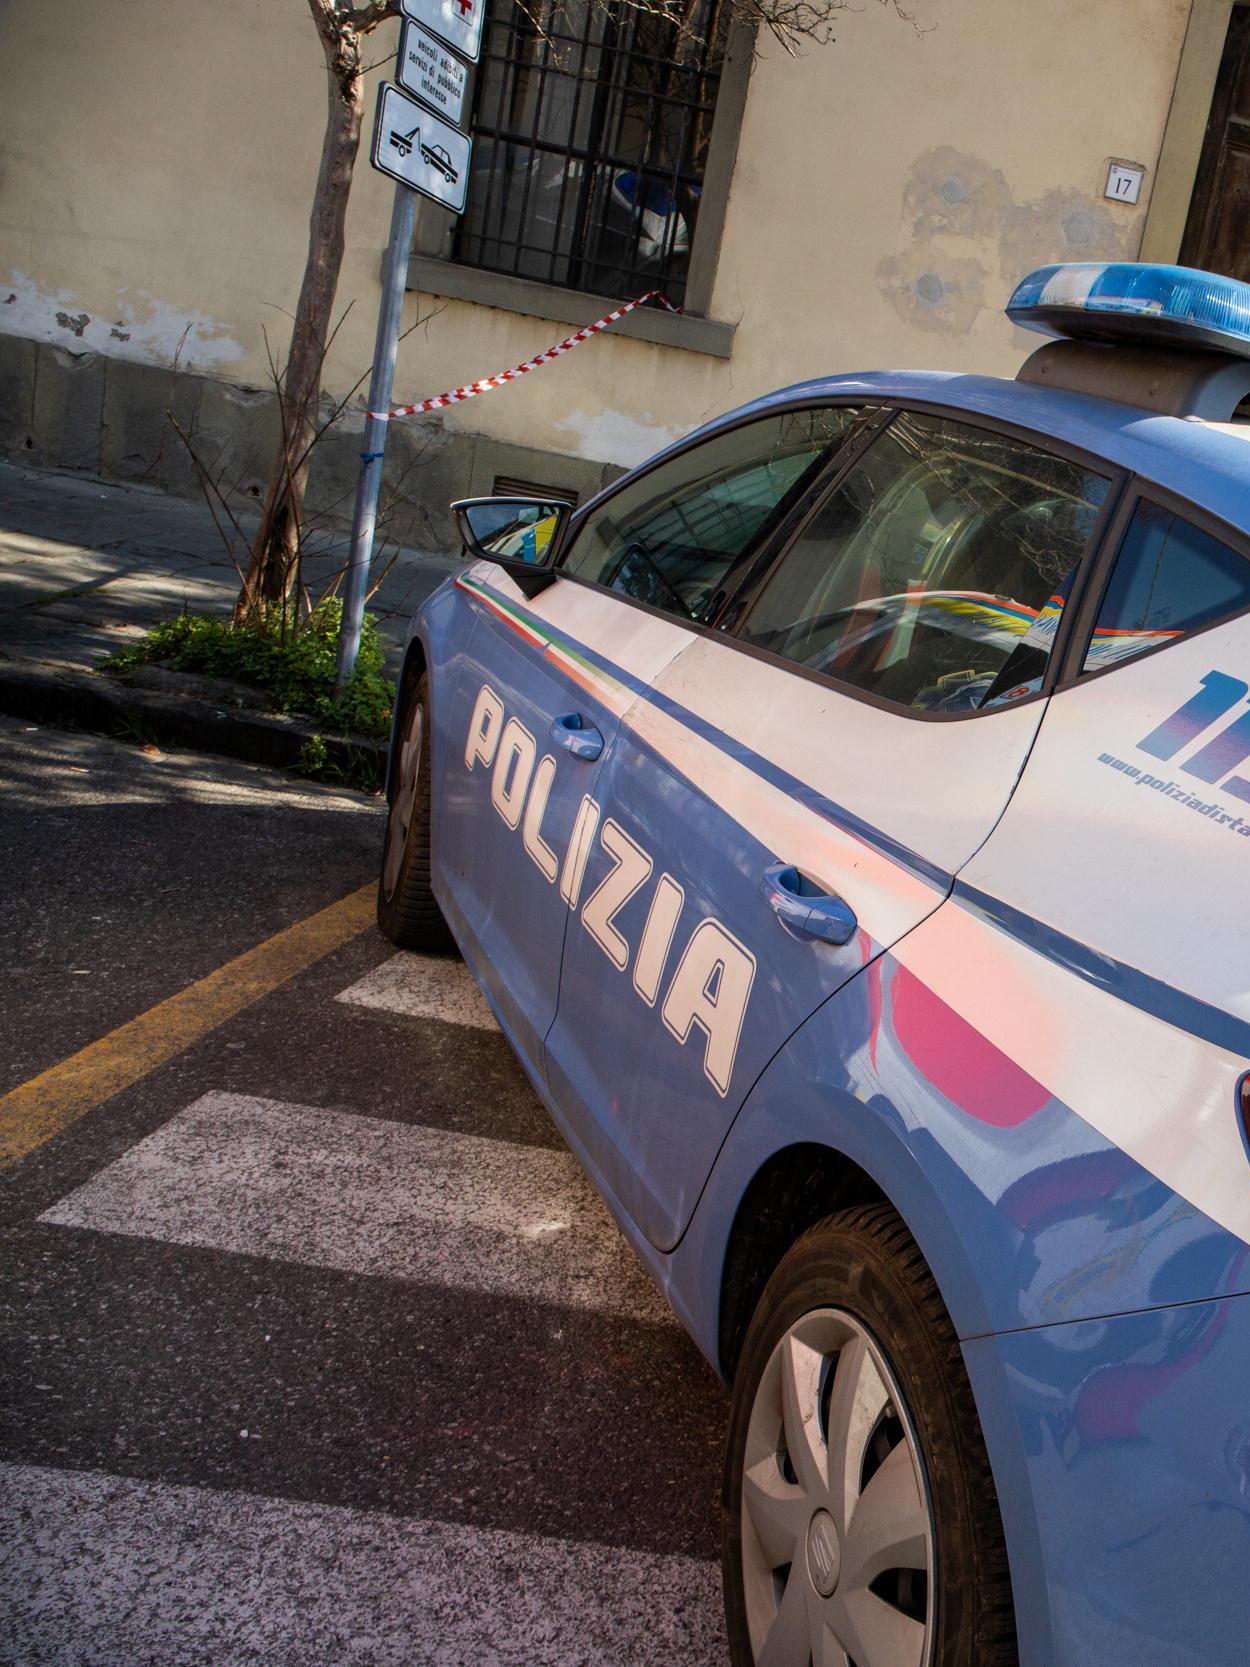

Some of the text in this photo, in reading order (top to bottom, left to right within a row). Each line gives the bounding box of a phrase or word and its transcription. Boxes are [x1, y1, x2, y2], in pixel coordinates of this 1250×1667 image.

[409, 51, 461, 99] servizi di pubblico
[418, 39, 438, 61] veicoli
[440, 58, 459, 80] adibiti
[421, 75, 448, 104] interesse
[1115, 177, 1132, 195] 17
[463, 683, 758, 1099] POLIZIA
